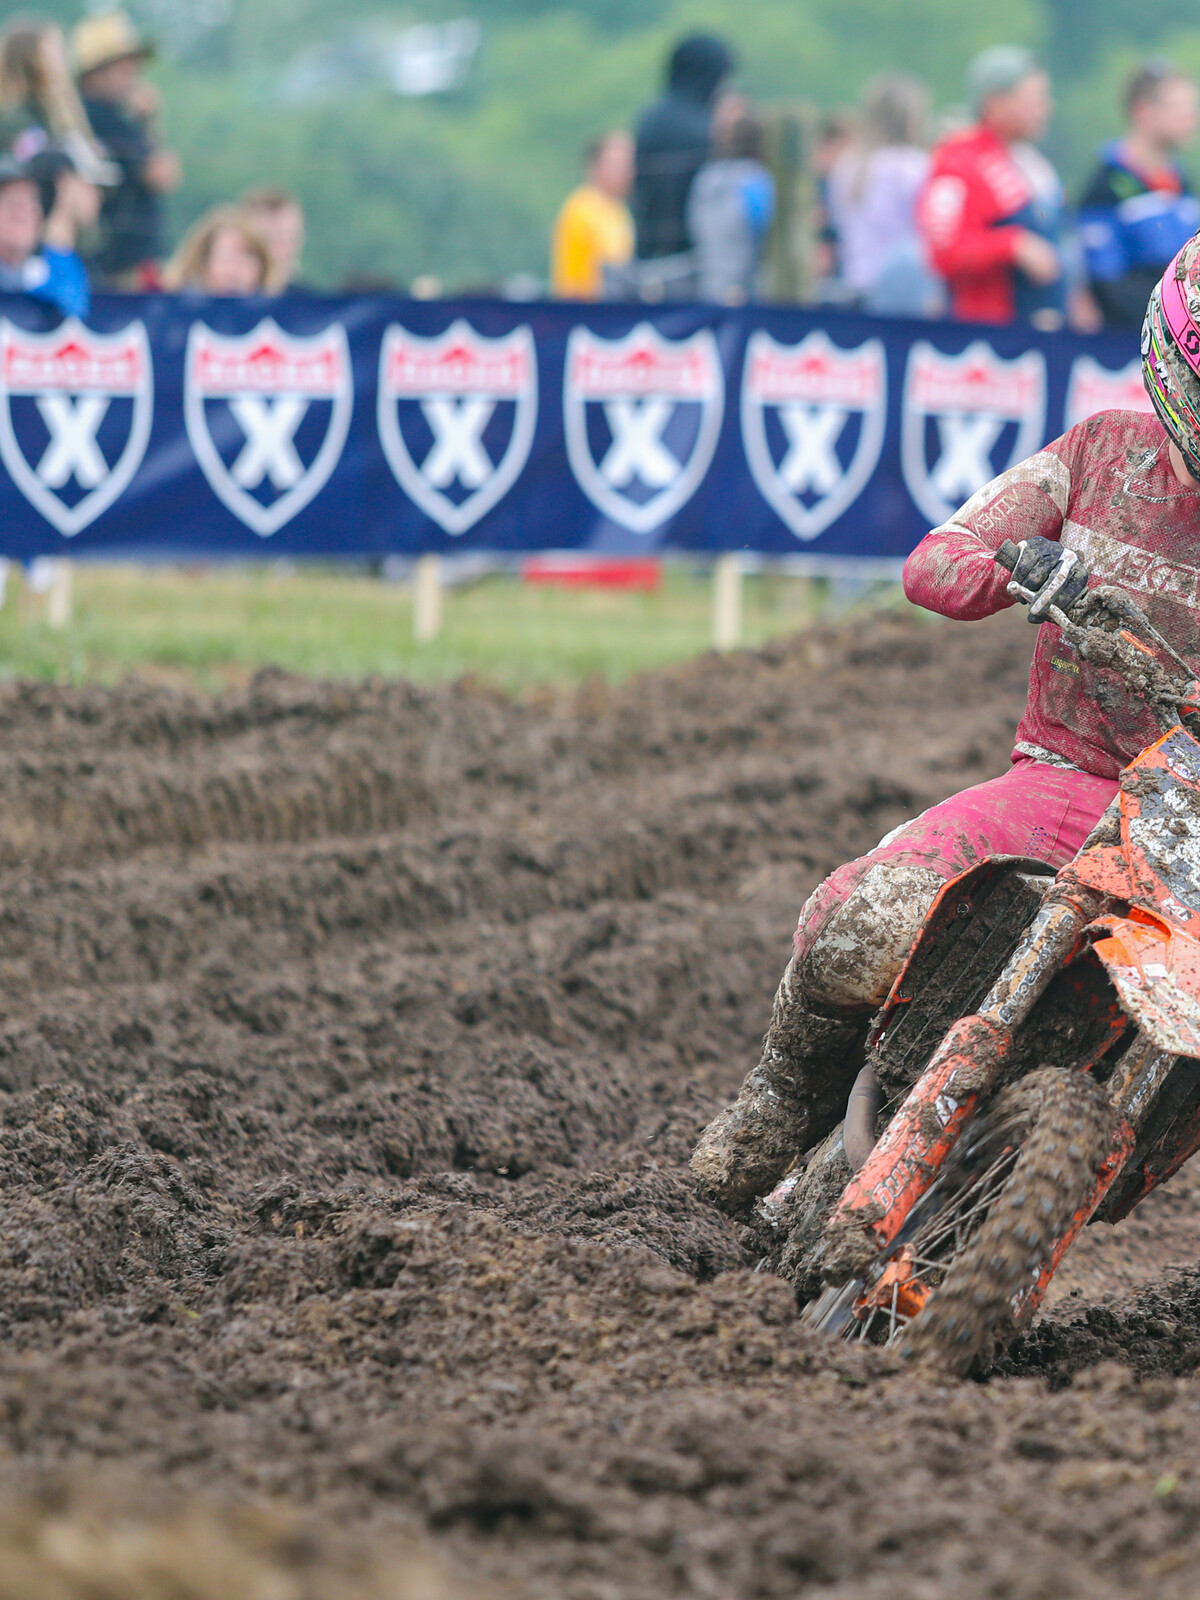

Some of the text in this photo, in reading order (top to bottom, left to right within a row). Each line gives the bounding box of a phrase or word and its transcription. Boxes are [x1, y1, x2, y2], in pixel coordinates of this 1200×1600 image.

[35, 395, 112, 489] X
[228, 396, 307, 490] X
[417, 397, 497, 490] X
[600, 399, 682, 489] X
[780, 406, 849, 494] X
[936, 413, 1000, 501] X
